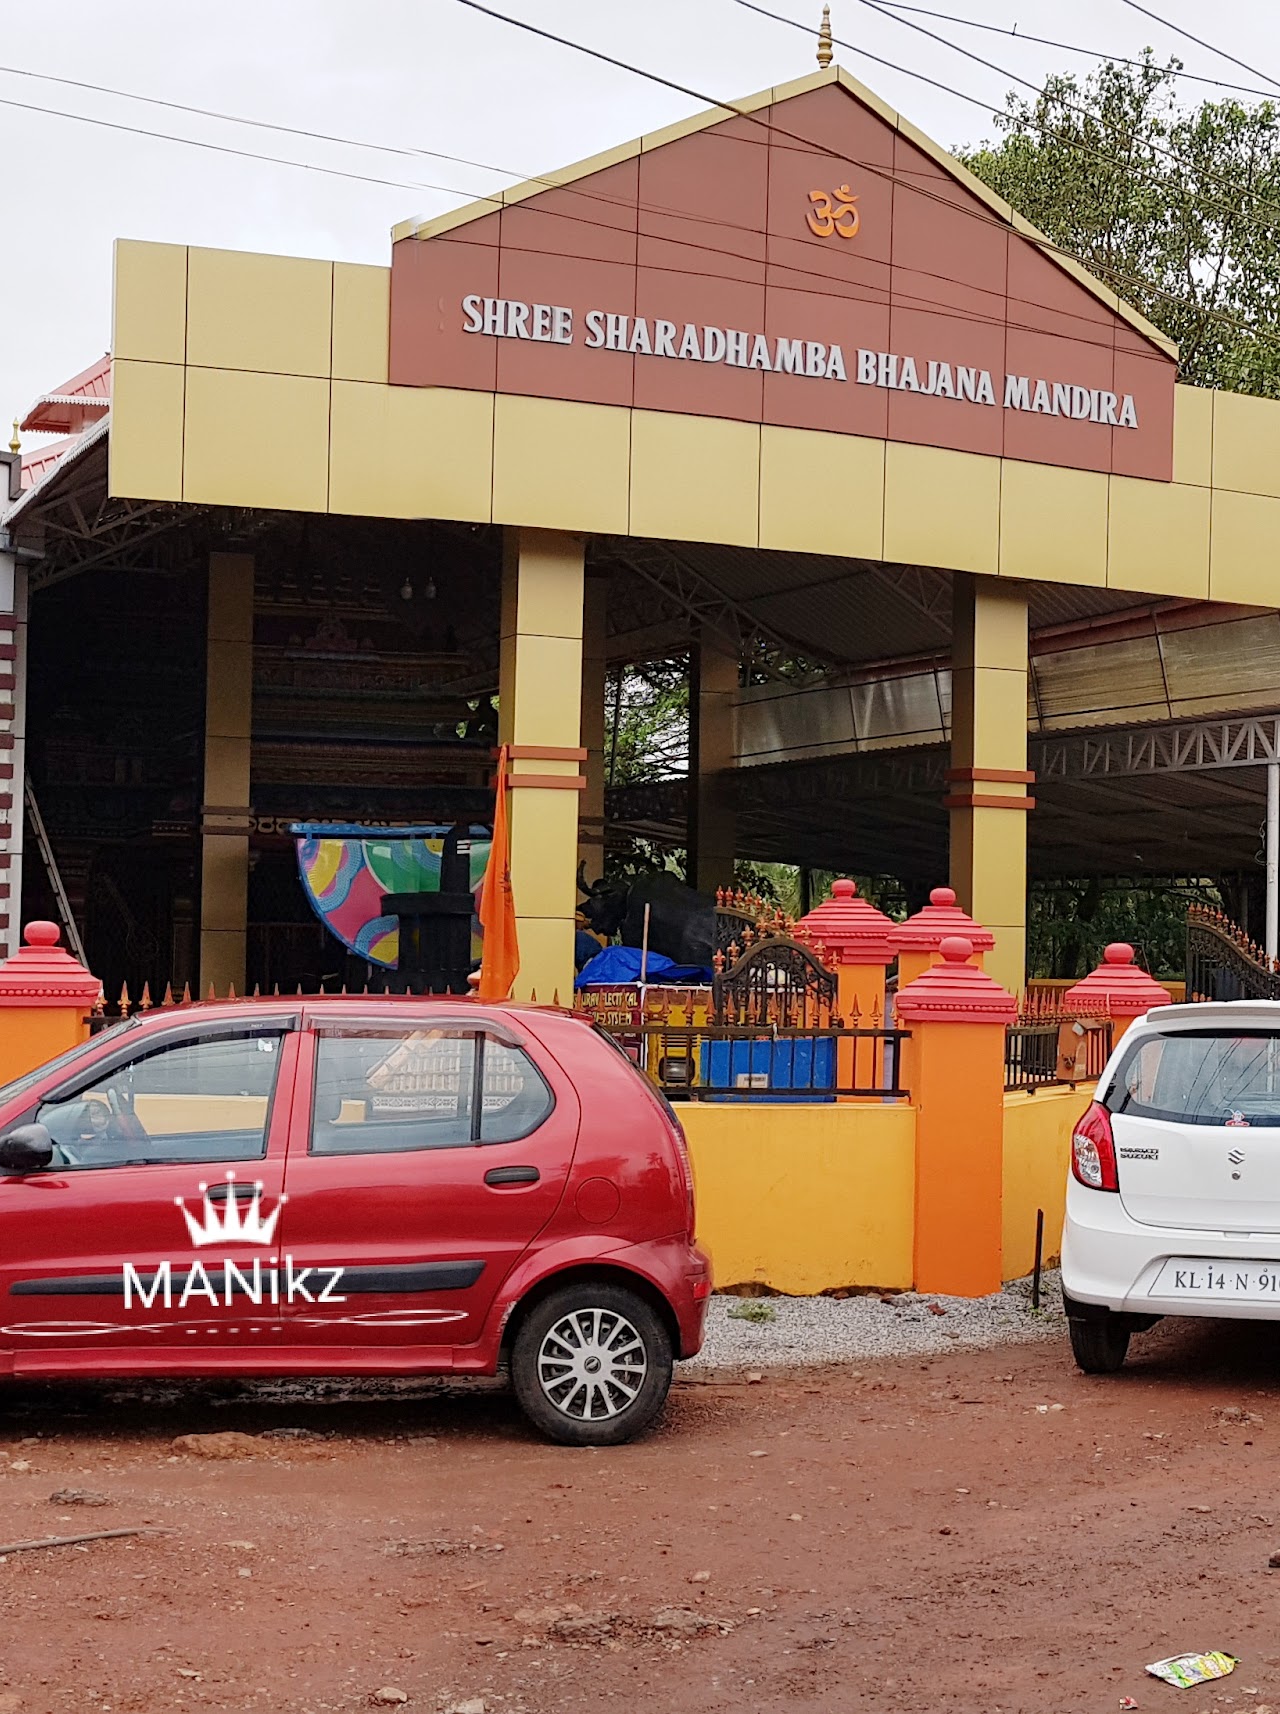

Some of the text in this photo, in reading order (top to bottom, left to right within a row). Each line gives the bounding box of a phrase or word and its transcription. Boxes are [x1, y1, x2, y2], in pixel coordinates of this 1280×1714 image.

[461, 294, 1139, 430] SHREE SHARADHAMBA BHAJANA MANDIRA
[1175, 1271, 1201, 1289] KL
[1207, 1272, 1225, 1290] 14
[1235, 1273, 1249, 1290] N
